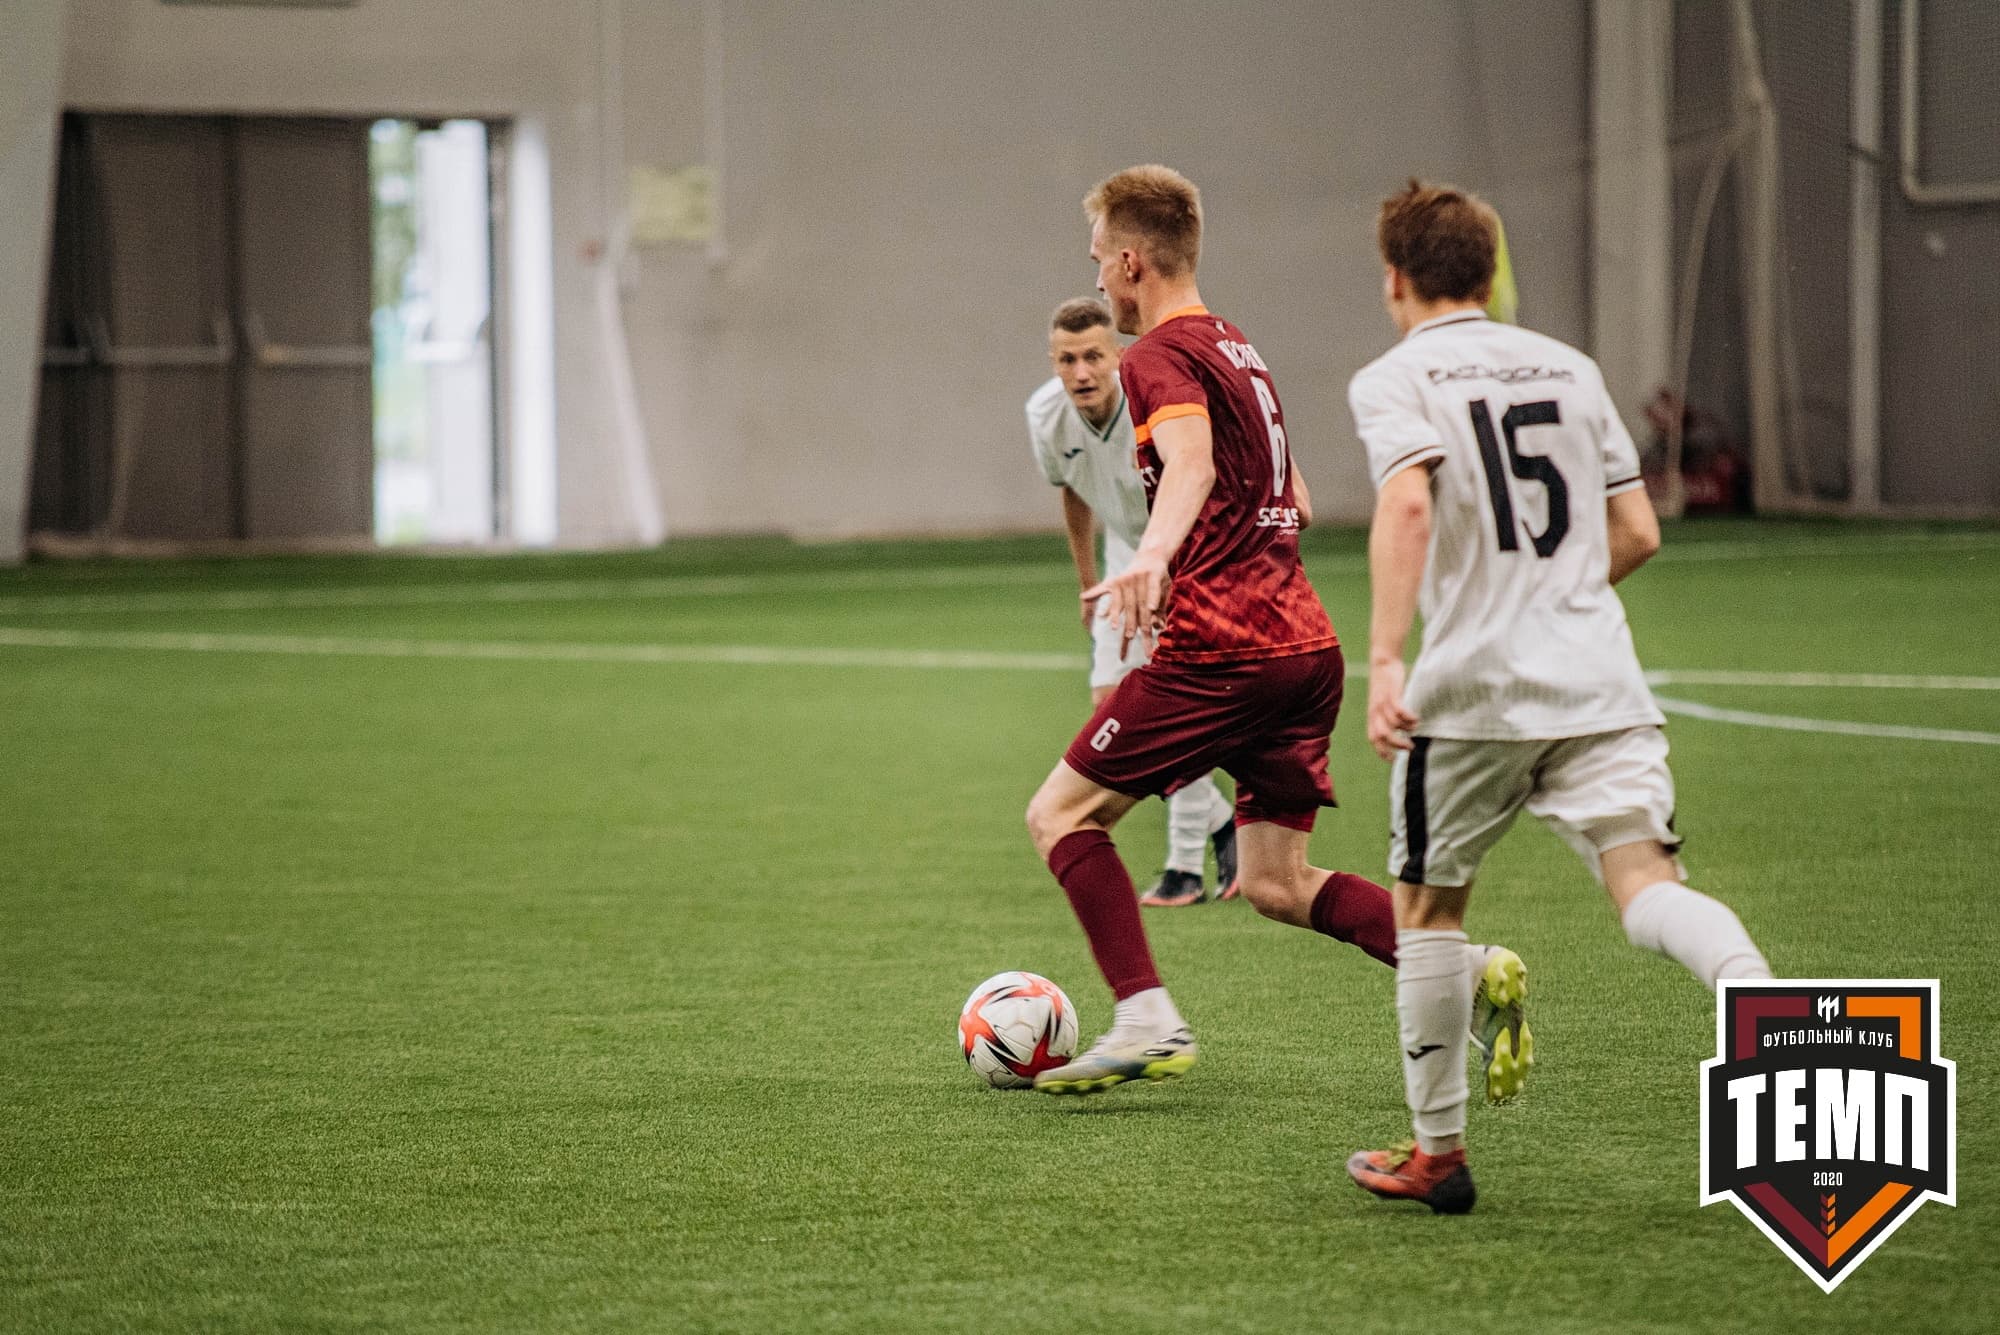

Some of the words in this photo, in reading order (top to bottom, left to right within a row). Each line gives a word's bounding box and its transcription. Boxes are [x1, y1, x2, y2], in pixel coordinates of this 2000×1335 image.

[1250, 375, 1287, 497] 6
[1469, 398, 1570, 558] 15
[1090, 717, 1121, 752] 6
